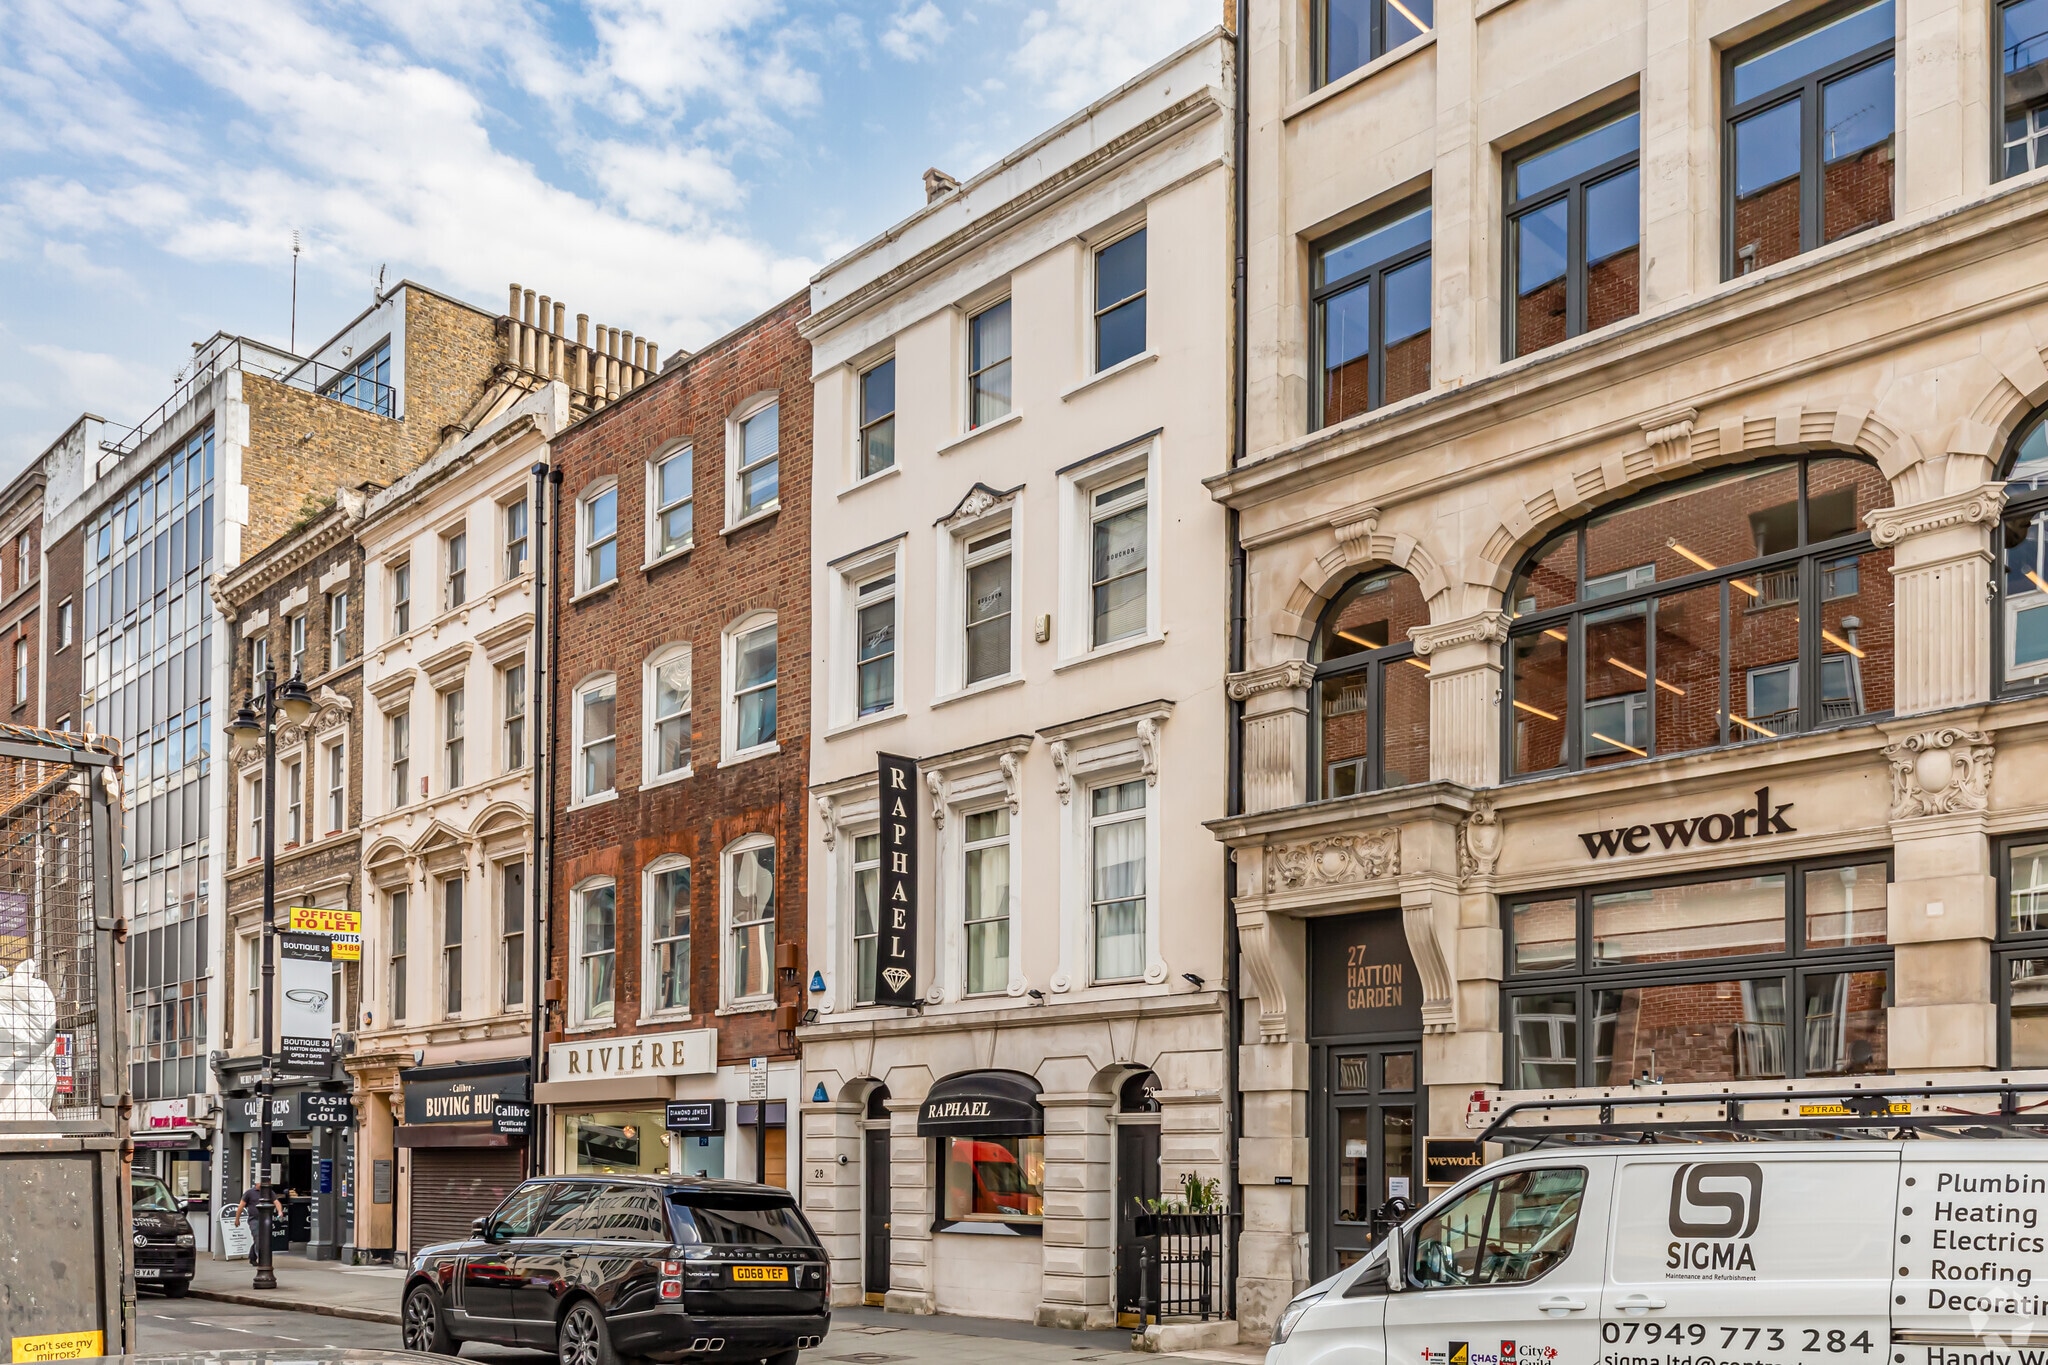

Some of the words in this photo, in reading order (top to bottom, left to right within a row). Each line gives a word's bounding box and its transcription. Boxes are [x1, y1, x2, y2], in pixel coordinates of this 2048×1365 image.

[1578, 786, 1797, 859] wework
[890, 768, 908, 958] RAPHAEL
[299, 910, 353, 921] OFFICE
[294, 918, 318, 929] TO
[324, 920, 358, 931] LET
[283, 942, 320, 951] BOUTIQUE
[1347, 945, 1367, 966] 27
[1347, 963, 1402, 988] HATTON
[1347, 986, 1402, 1010] GARDEN
[284, 1038, 320, 1046] BOUTIQUE
[569, 1040, 685, 1074] RIVIÉRE
[452, 1084, 472, 1092] Calibre
[1144, 1087, 1156, 1098] 28
[272, 1100, 290, 1114] GEMS
[307, 1096, 347, 1105] CASH
[426, 1095, 470, 1117] BUYING
[495, 1105, 530, 1117] Calibre
[928, 1102, 991, 1118] RAPHAEL
[307, 1113, 347, 1122] GOLD
[1428, 1152, 1482, 1166] wework
[815, 1169, 824, 1178] 28
[1937, 1173, 2046, 1194] Plumbin
[1934, 1202, 2038, 1229] Heating
[1933, 1229, 2045, 1253] Electrics
[1666, 1242, 1756, 1271] SIGMA
[737, 1268, 763, 1279] GD68
[766, 1269, 783, 1279] YEF
[1714, 1273, 1757, 1281] Refurbishment
[1931, 1260, 2032, 1288] Roofing
[1602, 1322, 1706, 1345] 07949
[1720, 1327, 1785, 1351] 773
[1802, 1328, 1874, 1354] 284
[24, 1341, 53, 1352] Can't
[55, 1341, 73, 1350] see
[76, 1339, 93, 1349] my
[37, 1348, 81, 1361] mirrors?
[1471, 1354, 1498, 1363] CHAS
